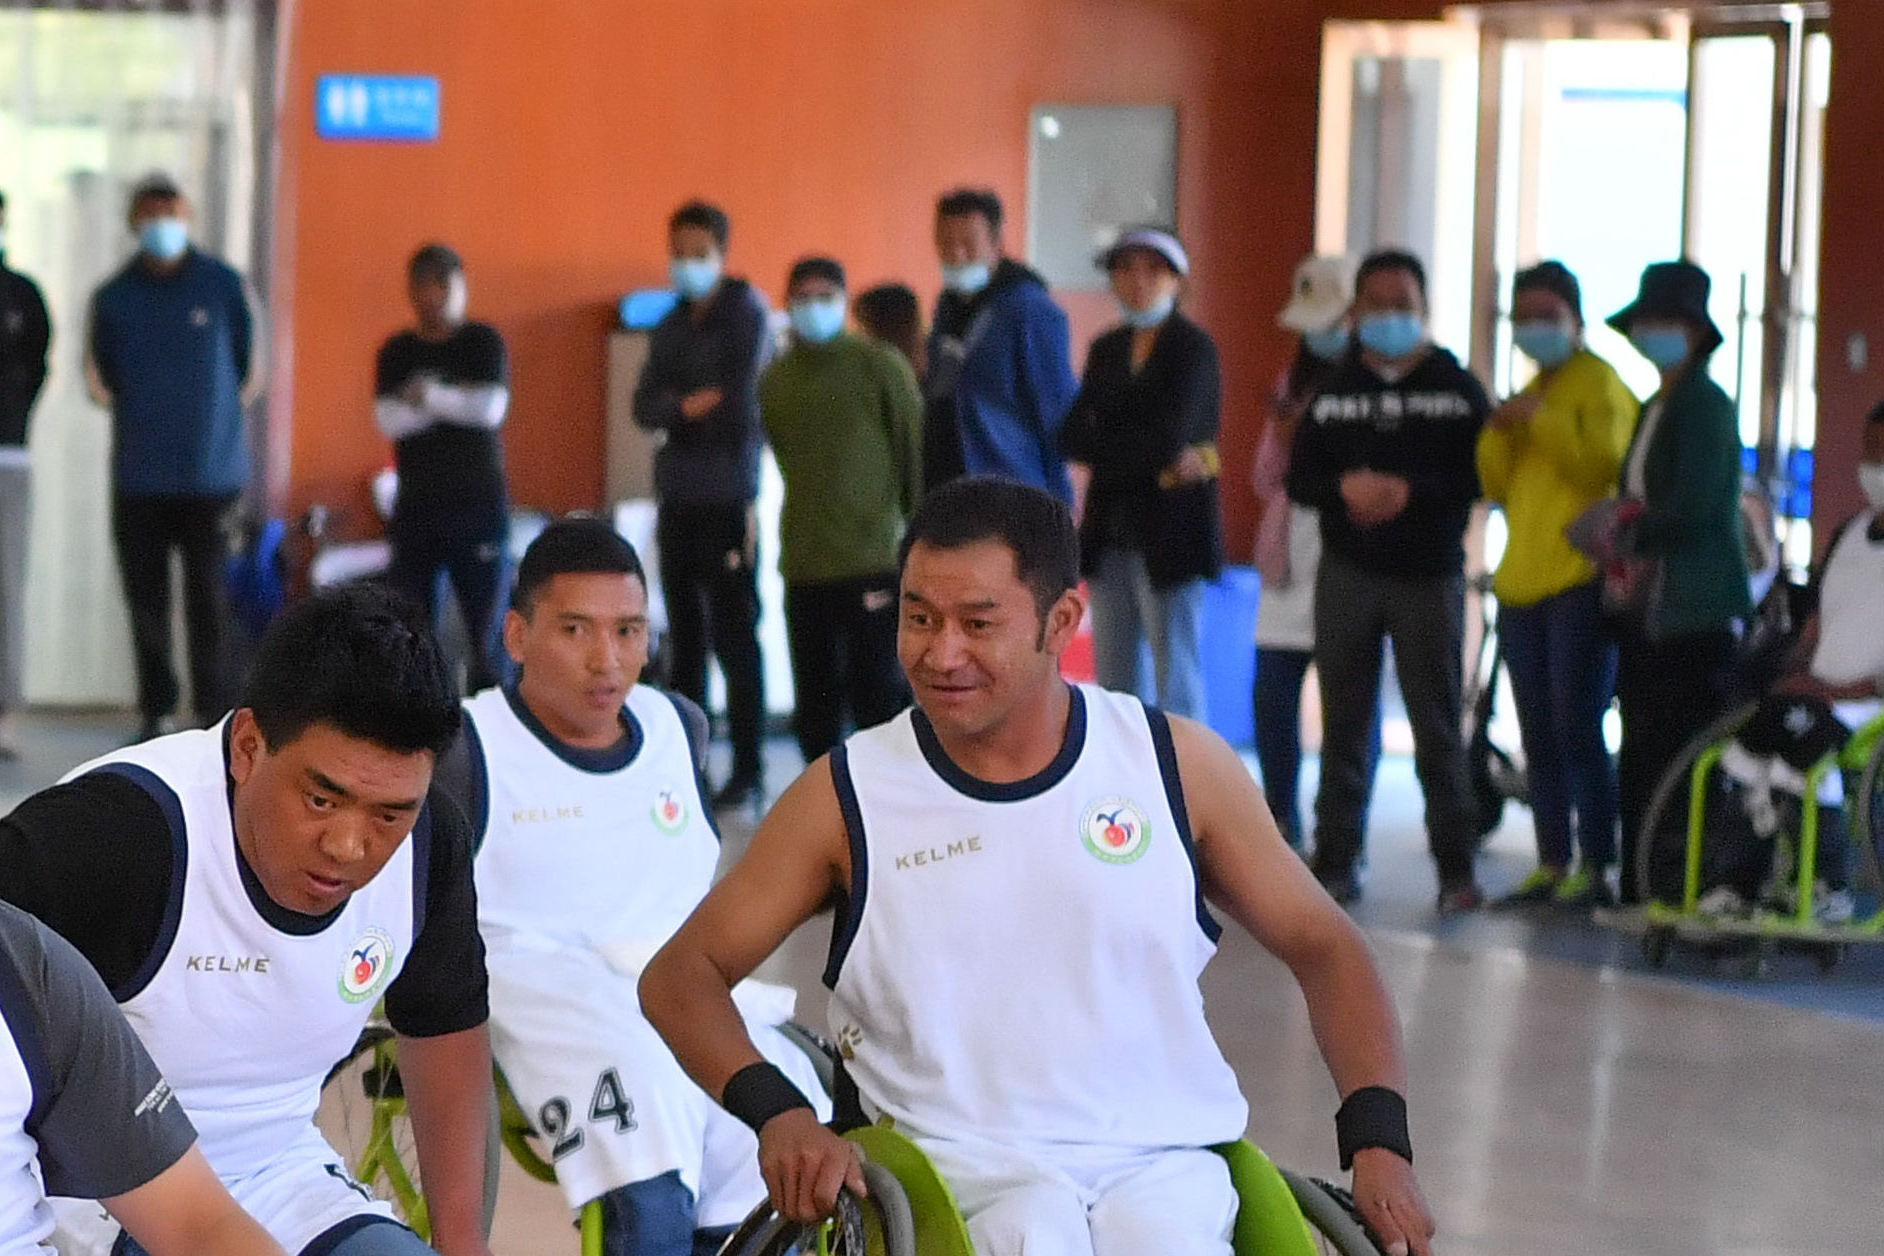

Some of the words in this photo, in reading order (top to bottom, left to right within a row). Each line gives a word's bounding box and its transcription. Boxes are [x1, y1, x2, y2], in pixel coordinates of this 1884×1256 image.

[512, 806, 585, 824] KELME
[895, 836, 983, 870] KELME
[186, 955, 270, 973] KELME
[538, 1066, 639, 1163] 24
